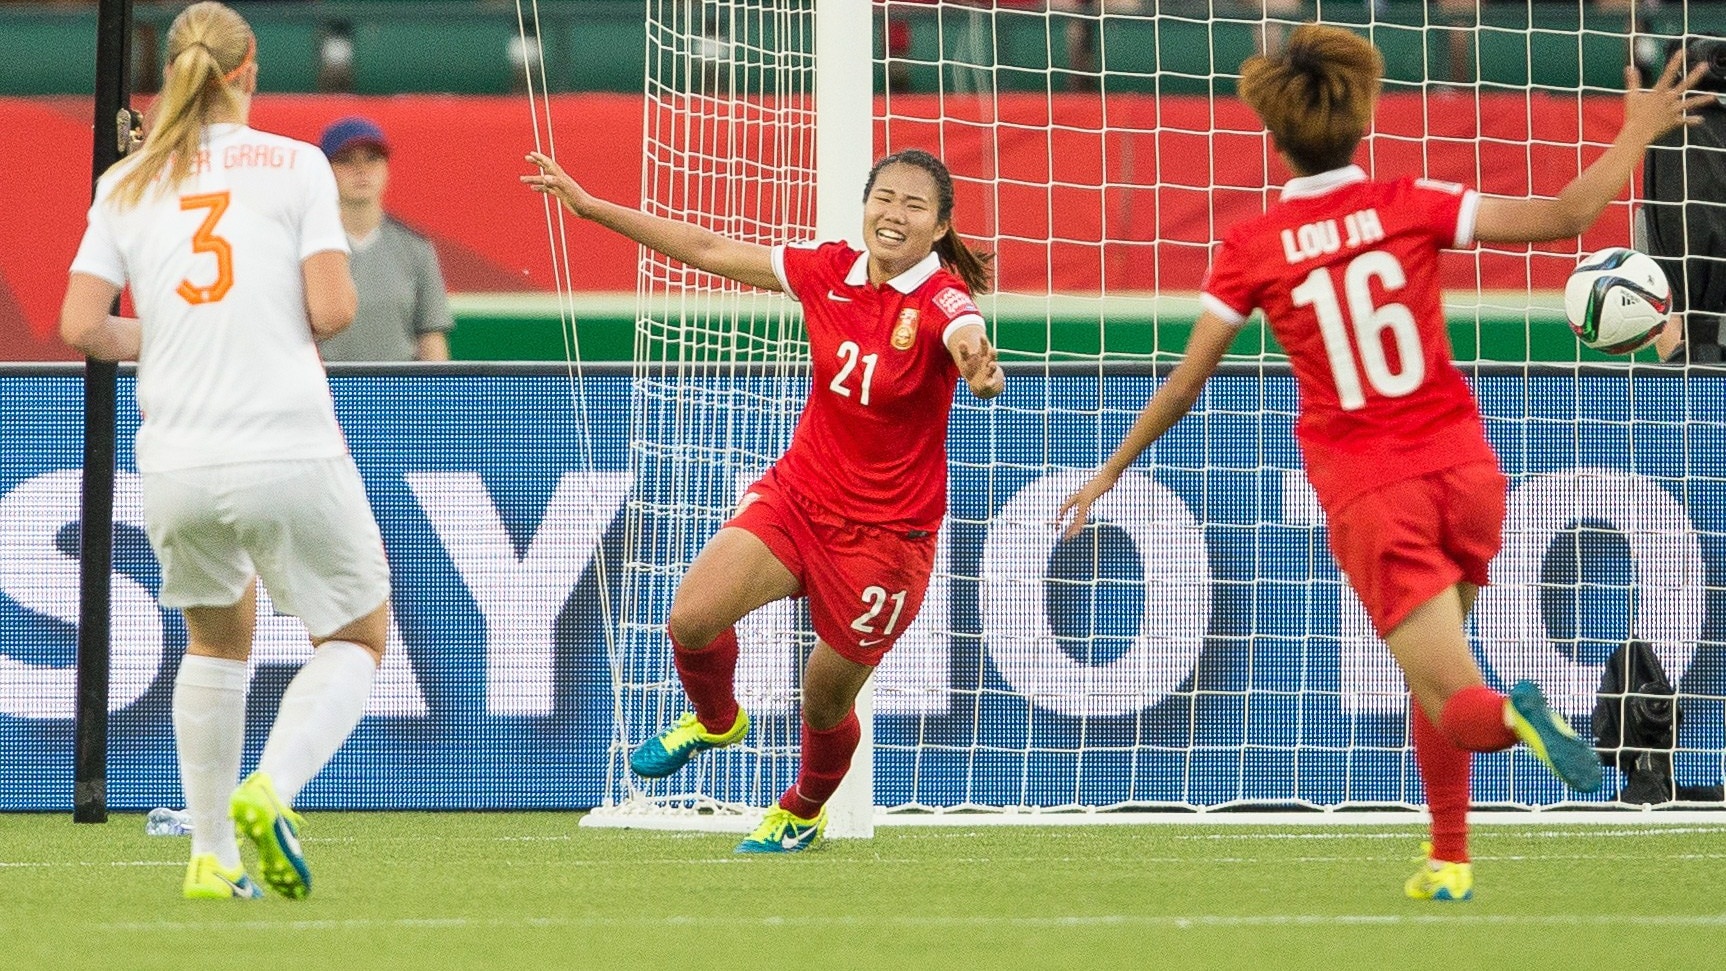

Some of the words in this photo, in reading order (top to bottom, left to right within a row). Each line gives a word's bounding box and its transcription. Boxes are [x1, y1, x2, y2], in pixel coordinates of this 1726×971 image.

[225, 144, 298, 170] GRAGT
[176, 190, 234, 306] 3
[1280, 219, 1341, 264] LOU
[1344, 208, 1384, 248] JH
[1290, 250, 1426, 411] 16
[829, 340, 878, 405] 21
[850, 585, 907, 636] 21
